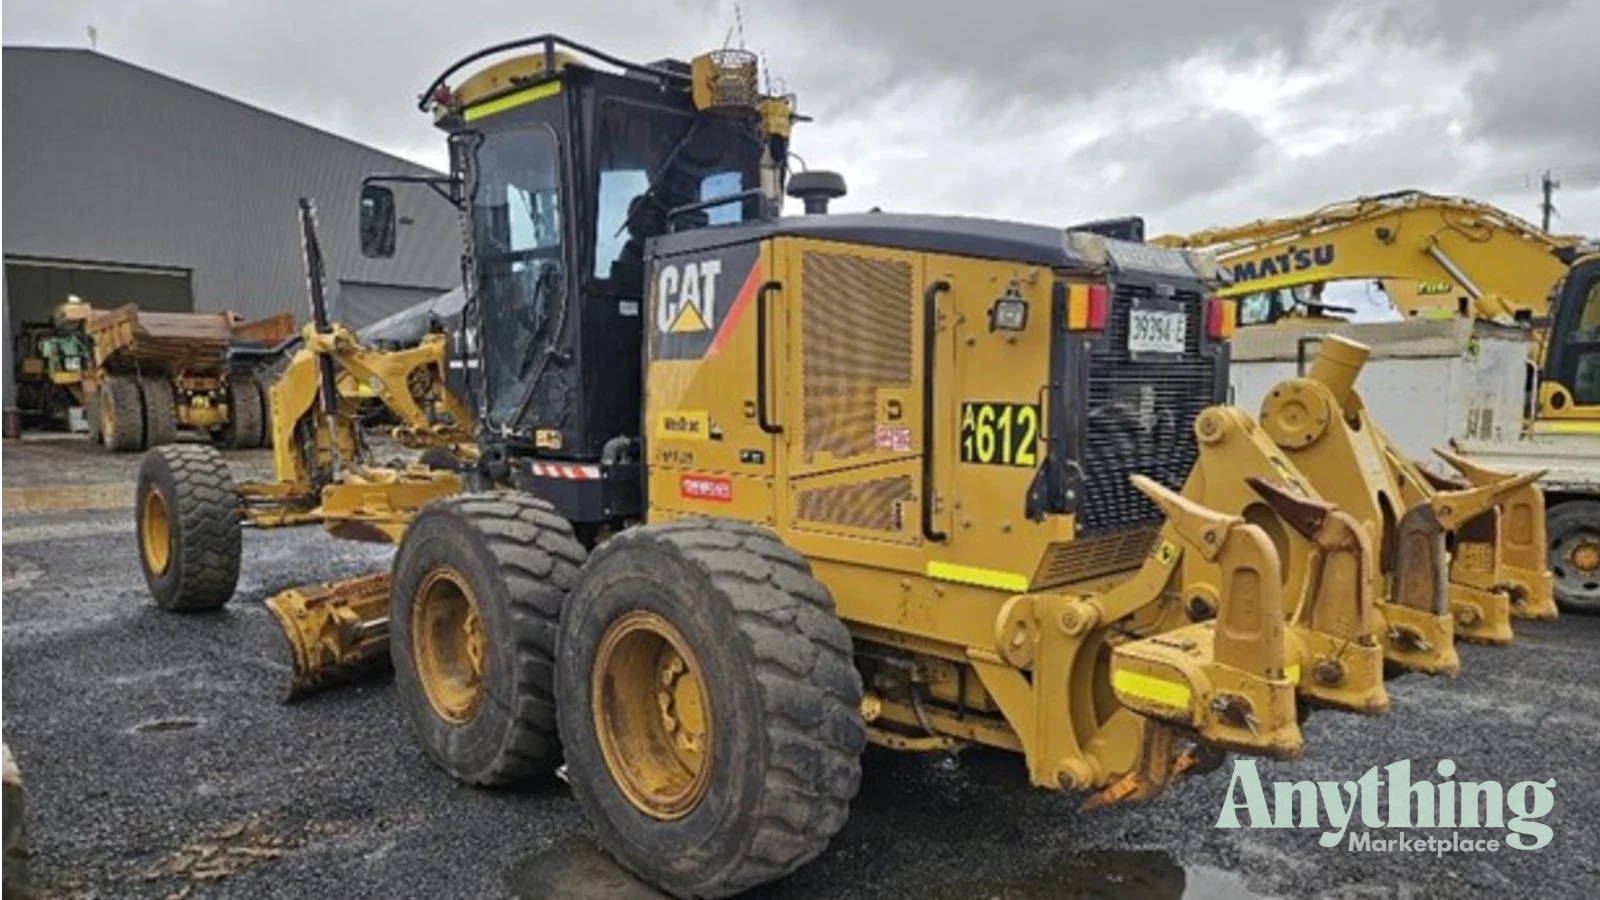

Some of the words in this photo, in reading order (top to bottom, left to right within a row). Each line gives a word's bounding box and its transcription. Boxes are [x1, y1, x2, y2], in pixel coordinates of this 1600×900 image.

[1217, 244, 1334, 282] MATSU
[658, 260, 722, 333] CAT
[976, 404, 1037, 465] 612
